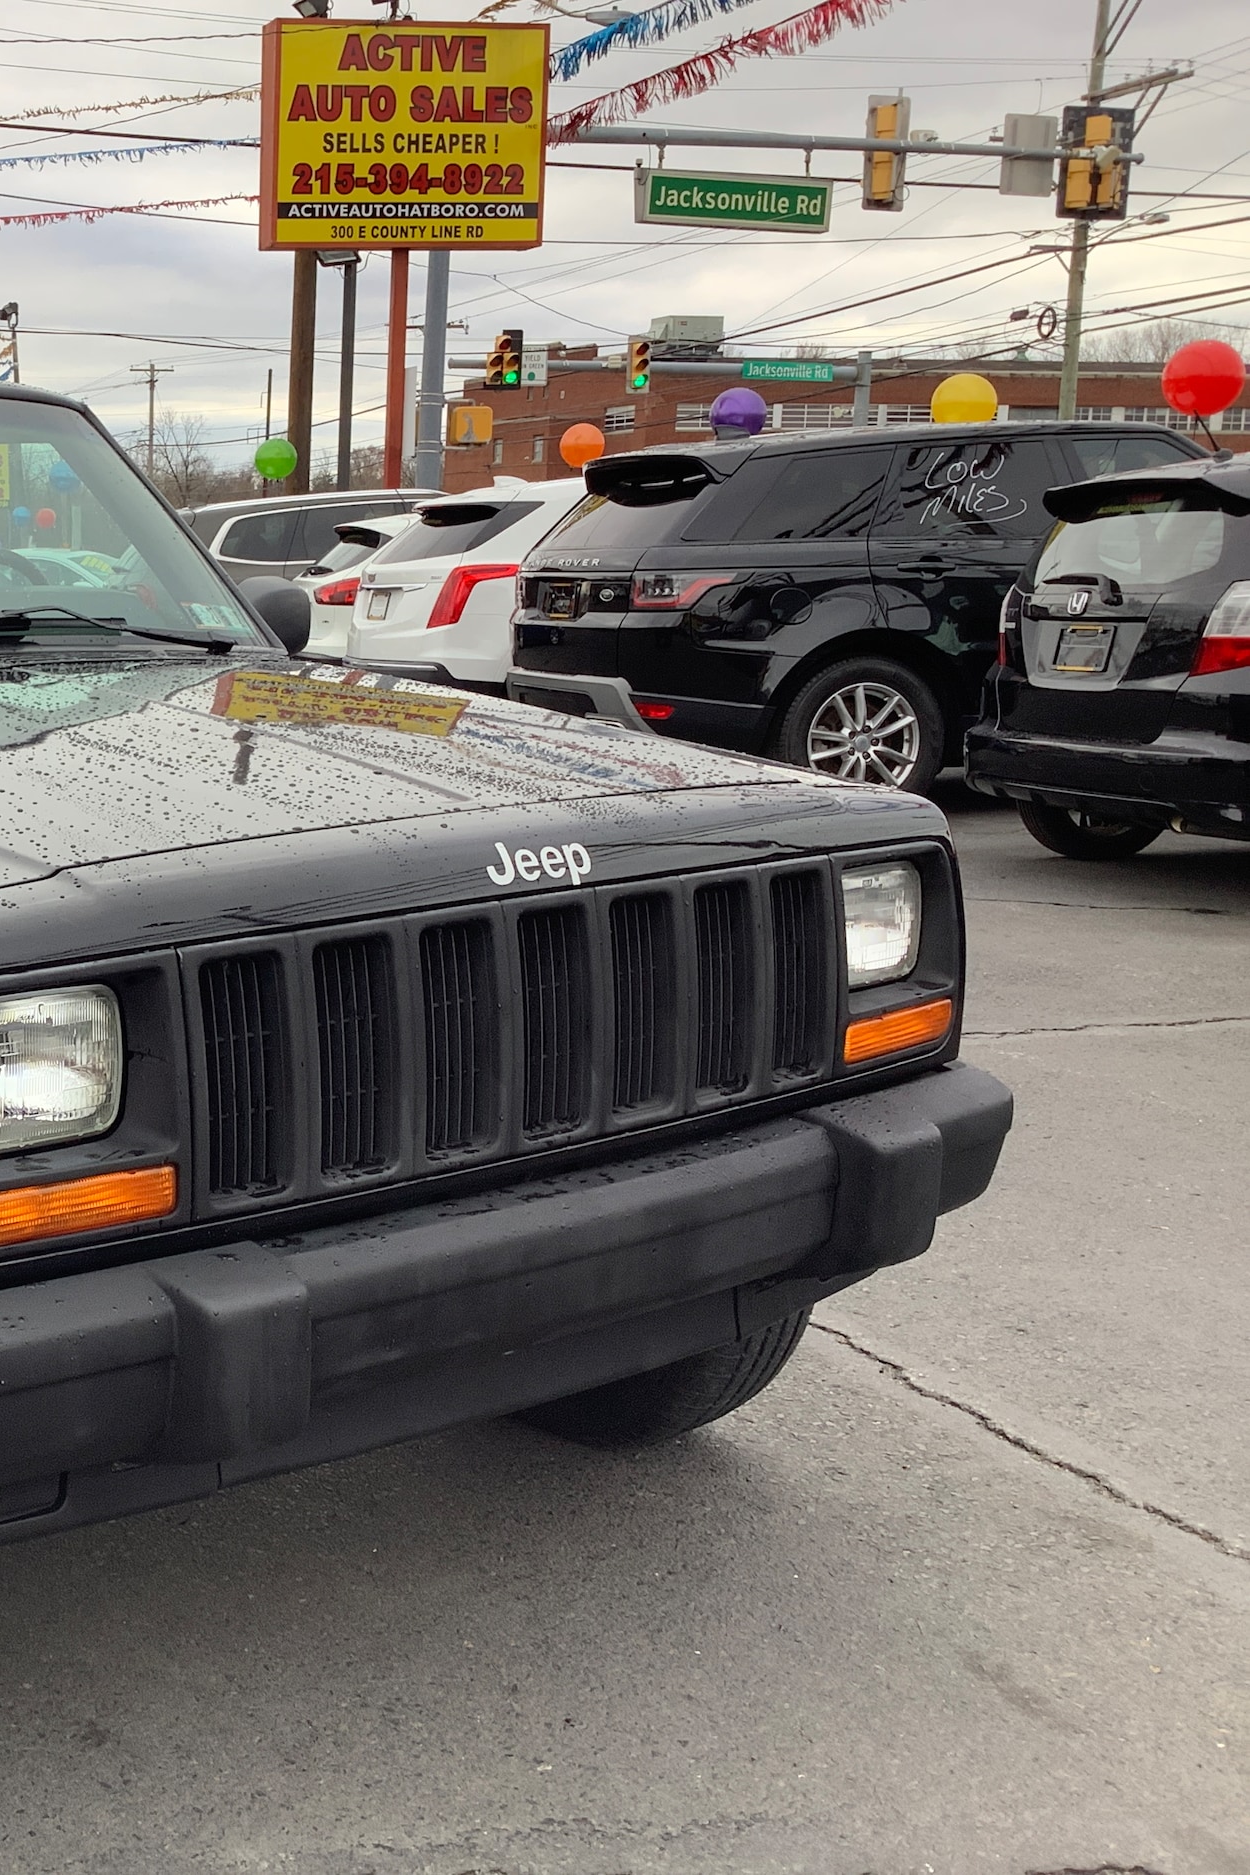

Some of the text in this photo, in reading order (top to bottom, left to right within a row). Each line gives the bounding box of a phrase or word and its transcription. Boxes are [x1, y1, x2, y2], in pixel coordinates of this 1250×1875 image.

[338, 33, 487, 73] ACTIVE
[287, 84, 533, 124] AUTO SALES
[322, 133, 385, 154] SELLS
[393, 133, 486, 154] CHEAPER
[291, 163, 525, 195] 215-394-8922
[288, 203, 525, 218] ACTIVEAUTOHATBORO.COM
[655, 185, 822, 216] Jacksonville Rd
[330, 225, 484, 239] 300 E COUNTY LINE RD
[747, 362, 828, 379] Jacksonville Rd
[925, 452, 1005, 489] LOW
[919, 483, 1009, 524] MILES
[557, 558, 600, 567] ROVER
[486, 842, 592, 886] Jeep
